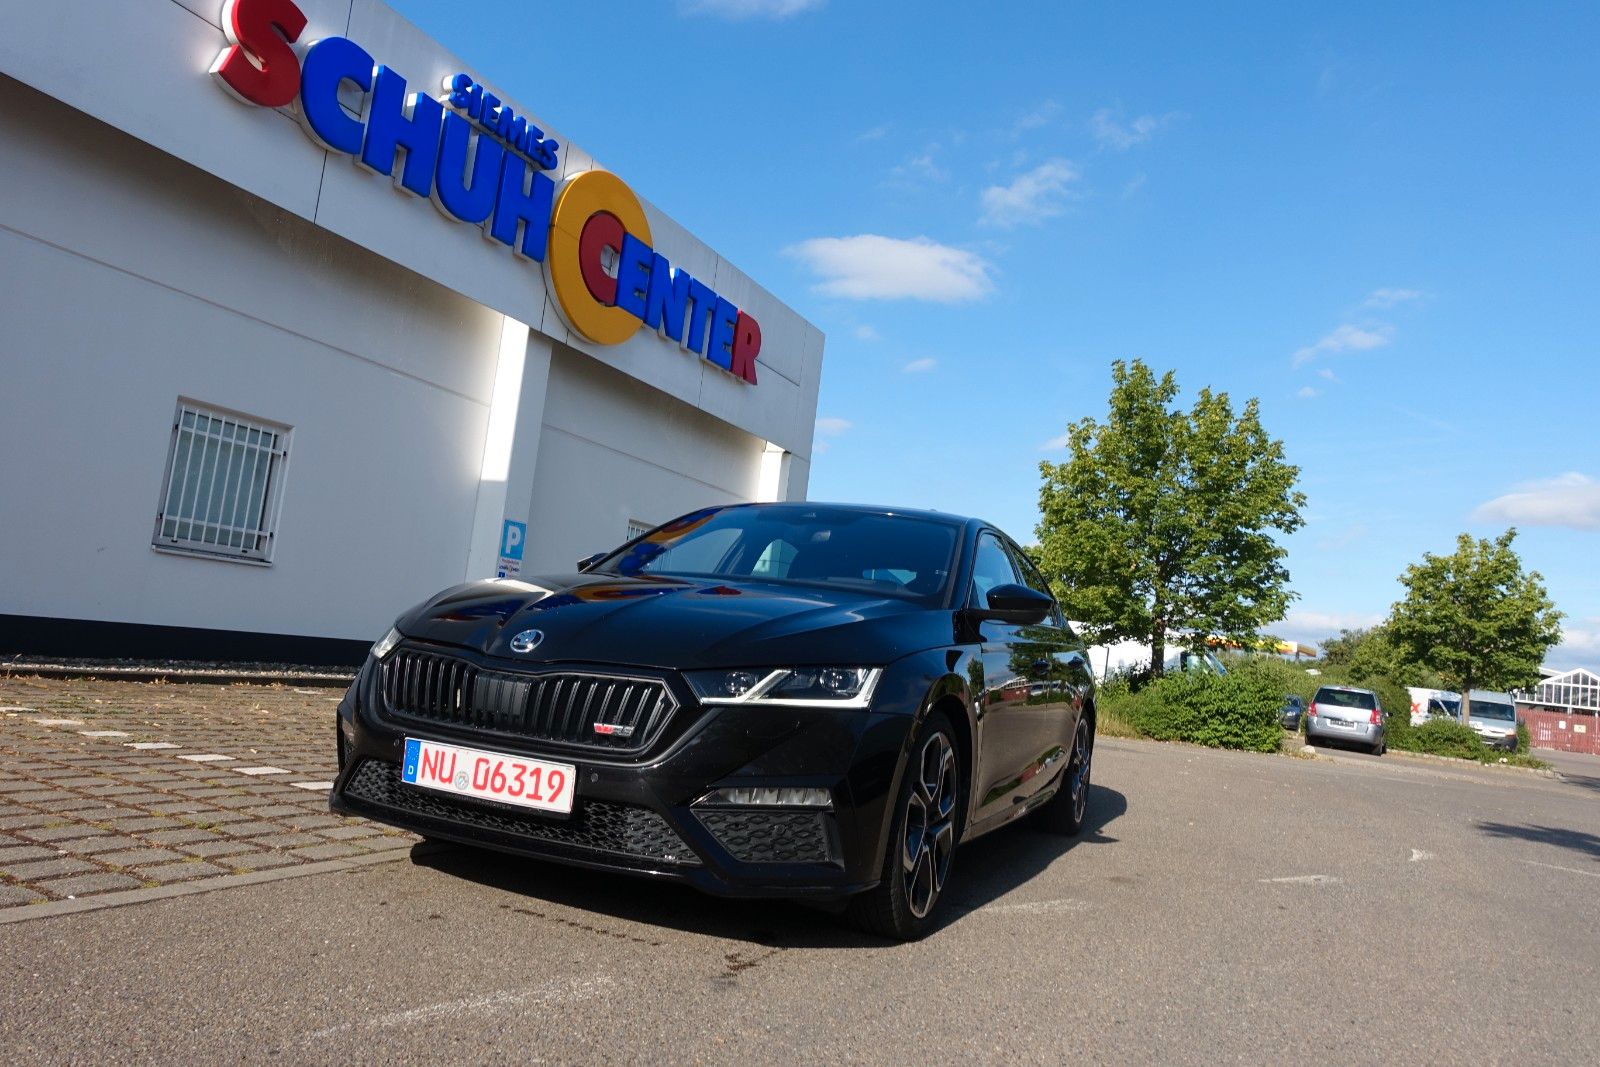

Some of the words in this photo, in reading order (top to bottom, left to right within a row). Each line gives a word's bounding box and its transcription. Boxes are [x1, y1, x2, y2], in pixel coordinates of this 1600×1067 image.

[444, 73, 560, 171] SIEMES
[210, 0, 556, 265] SCHUH
[578, 210, 762, 386] CENTER
[505, 525, 521, 554] P
[407, 764, 414, 775] D
[421, 747, 457, 784] NU
[472, 757, 565, 804] 06319
